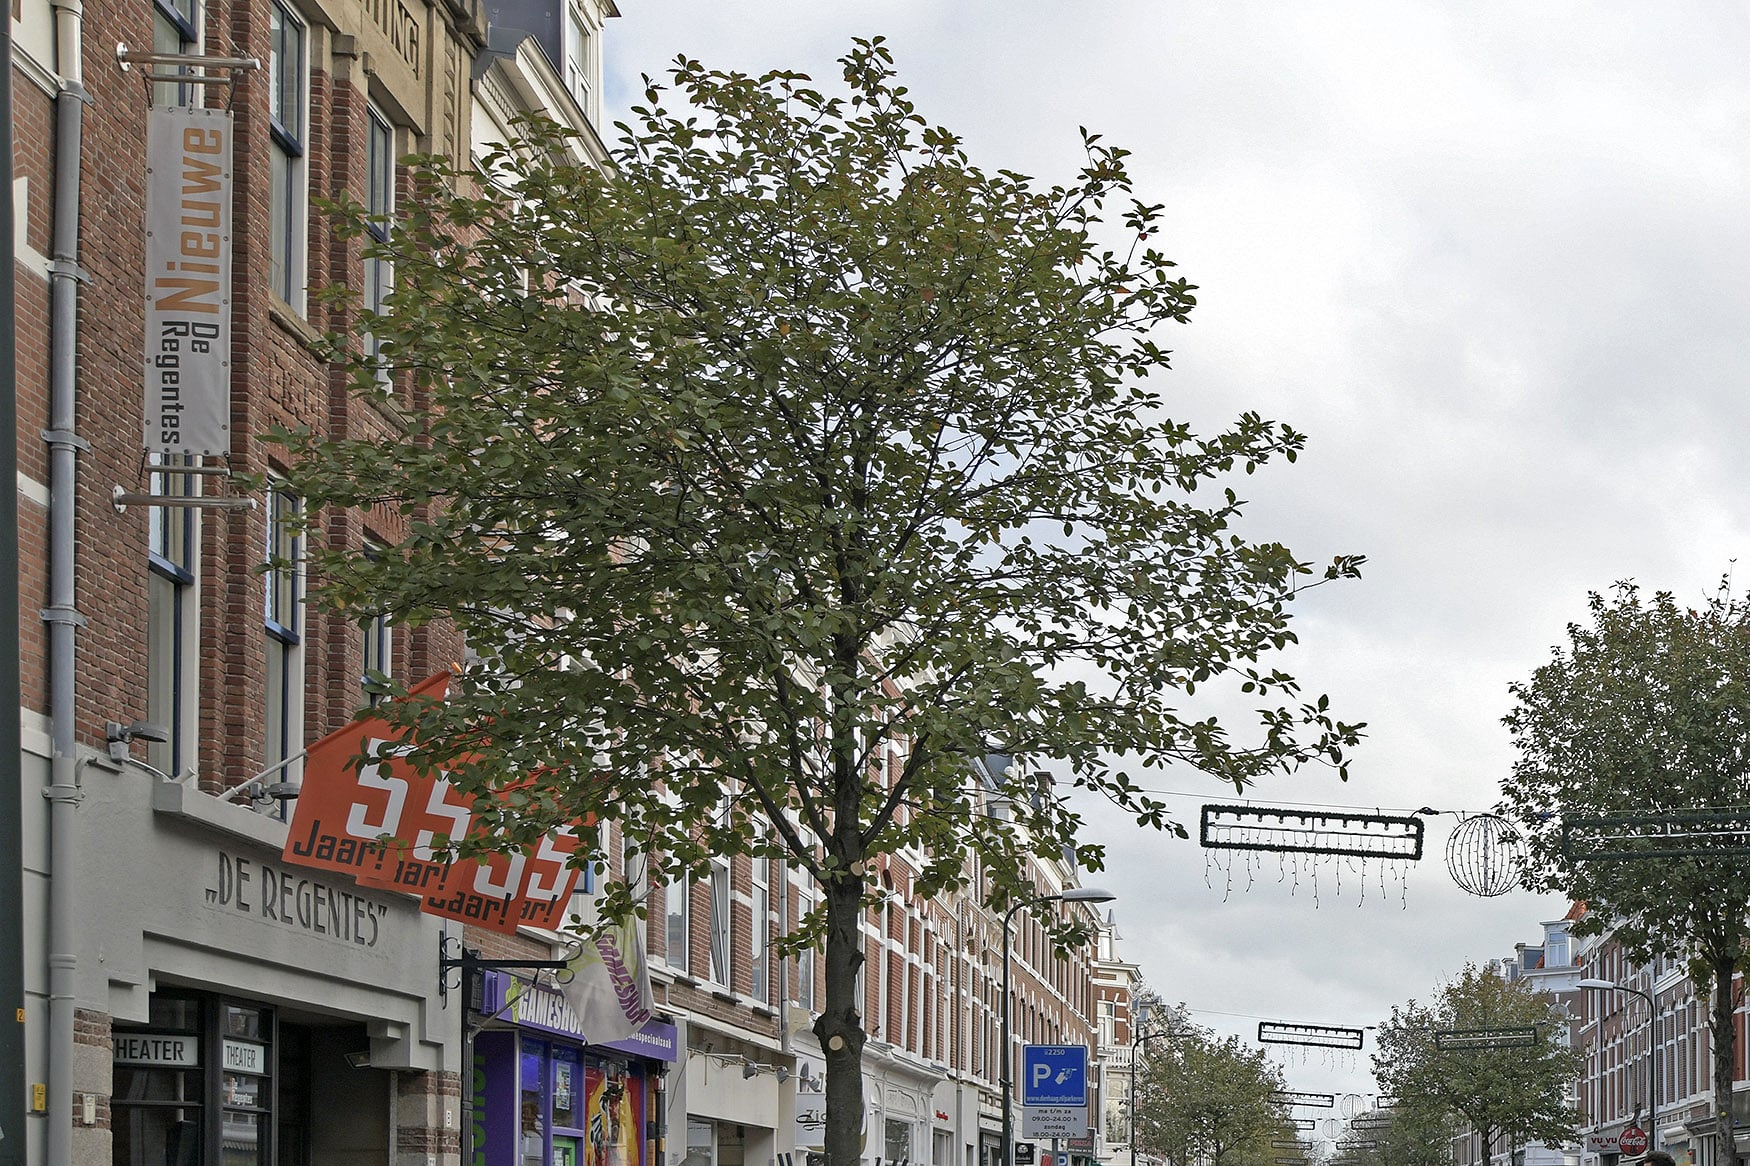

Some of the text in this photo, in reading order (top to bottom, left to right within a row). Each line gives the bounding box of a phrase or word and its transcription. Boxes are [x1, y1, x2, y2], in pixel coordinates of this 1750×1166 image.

[155, 127, 222, 314] Nieuwe
[191, 321, 220, 354] De
[155, 320, 190, 445] Regentes
[293, 819, 391, 870] Jaar!
[226, 1045, 256, 1068] THEATER
[1033, 1063, 1052, 1088] P
